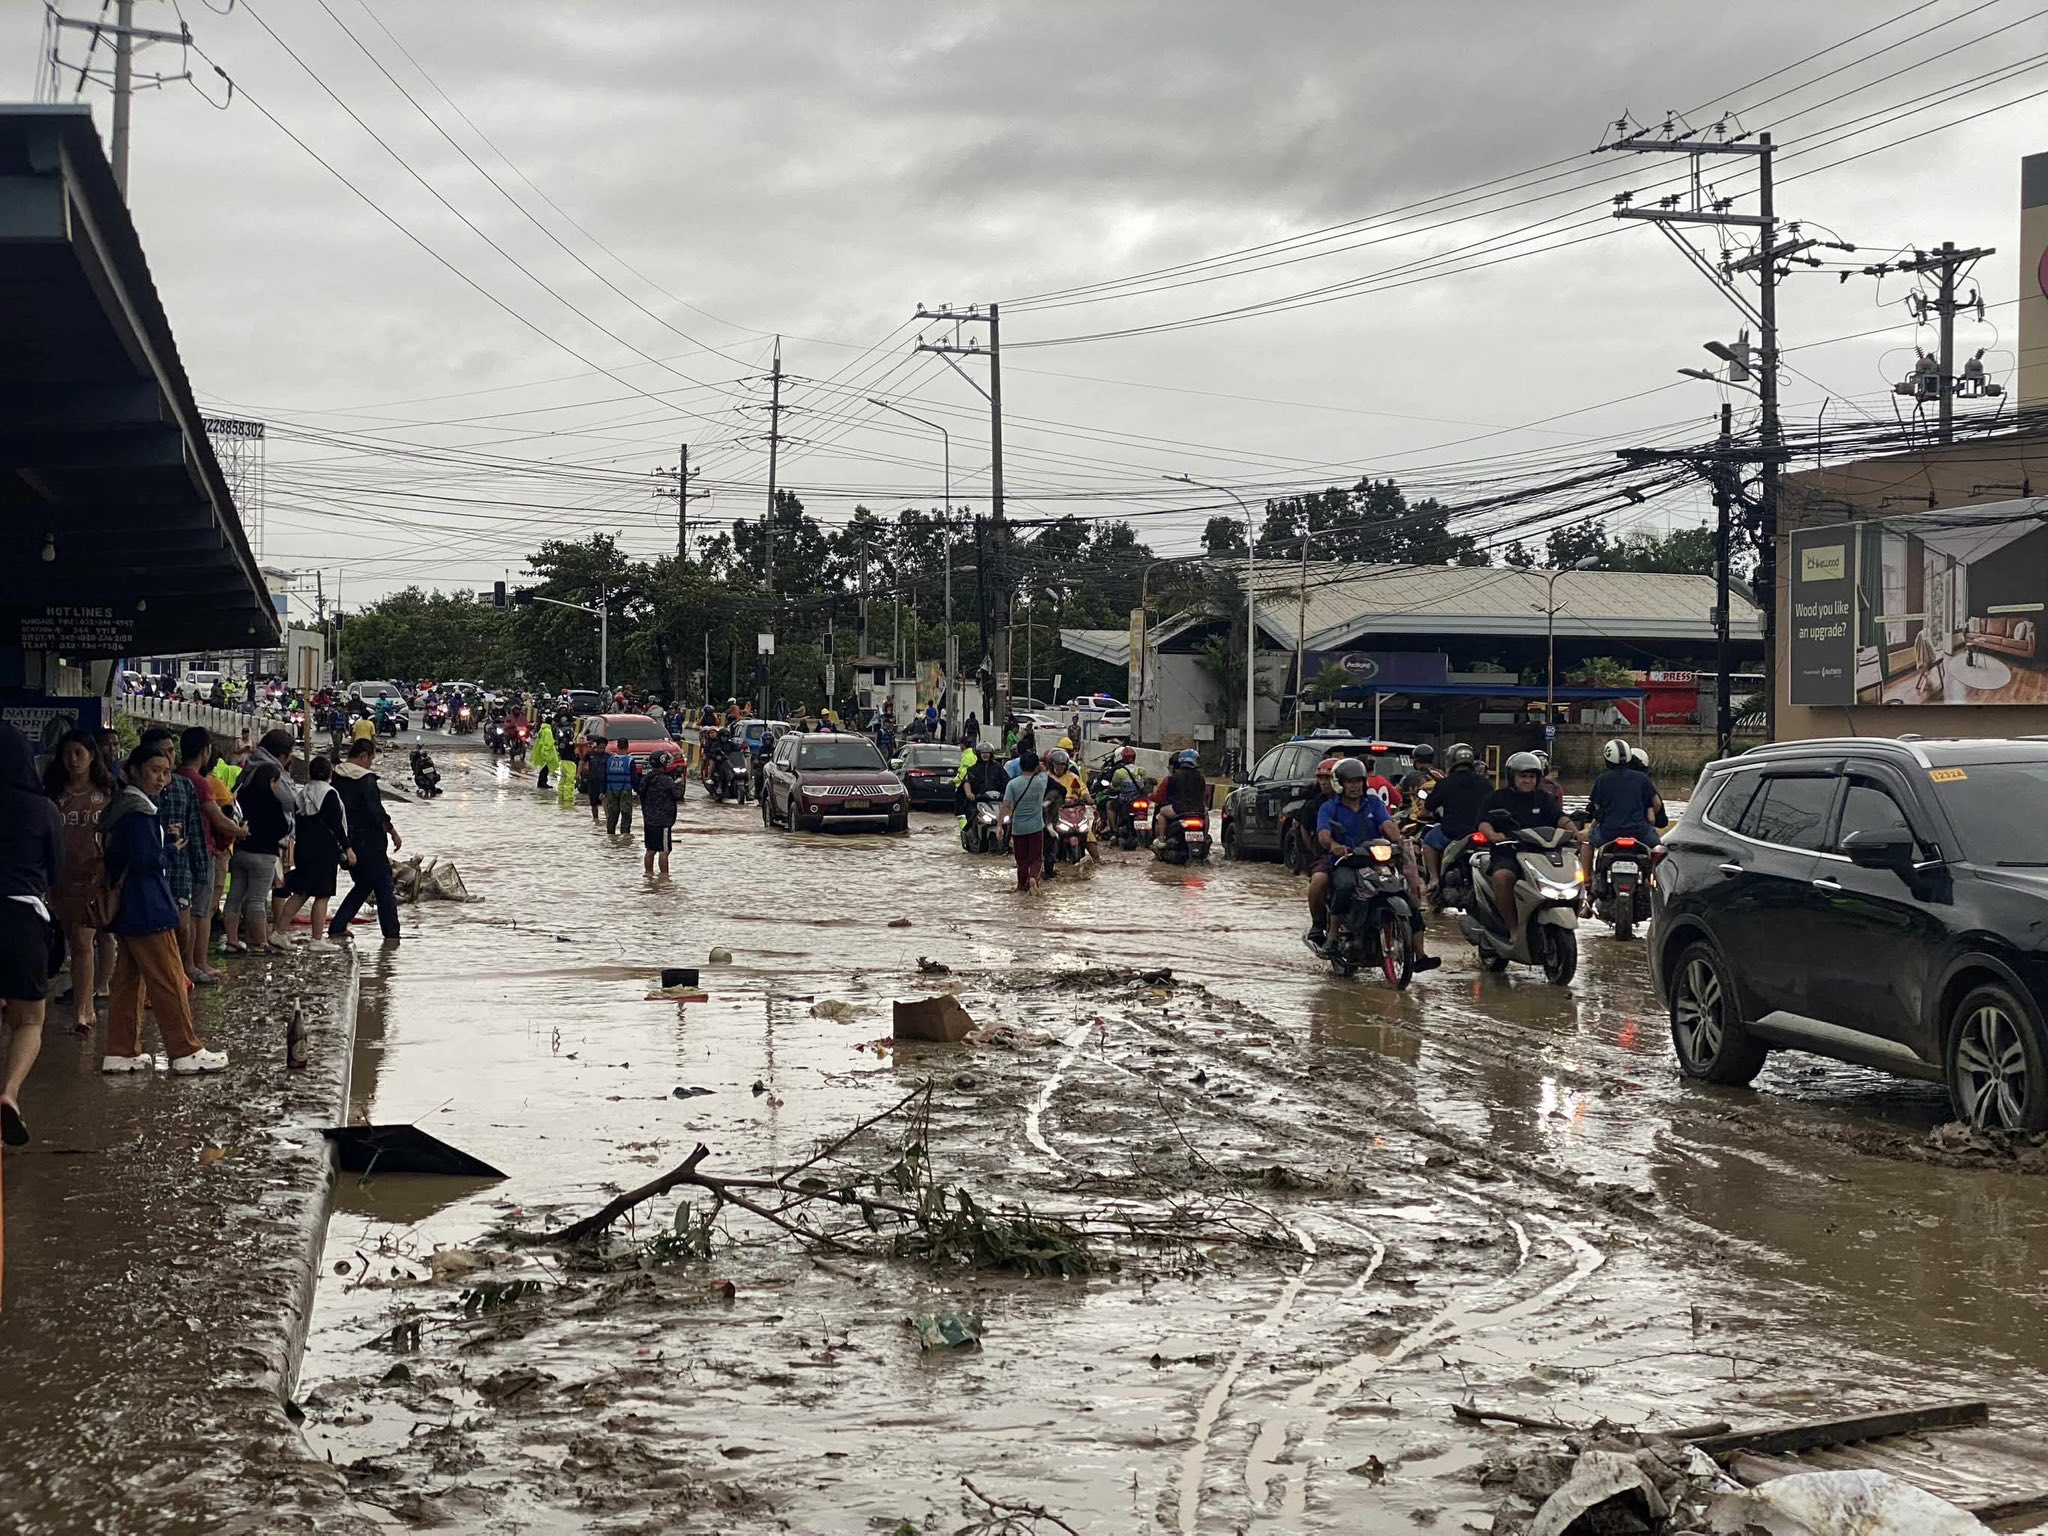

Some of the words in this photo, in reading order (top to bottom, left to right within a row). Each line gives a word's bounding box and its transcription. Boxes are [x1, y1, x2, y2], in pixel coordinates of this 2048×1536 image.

[47, 607, 113, 618] HOTLINES
[1795, 602, 1817, 617] Wood
[1818, 604, 1833, 619] you
[1834, 600, 1849, 615] like
[1799, 628, 1809, 639] an
[1810, 622, 1847, 641] upgrade?
